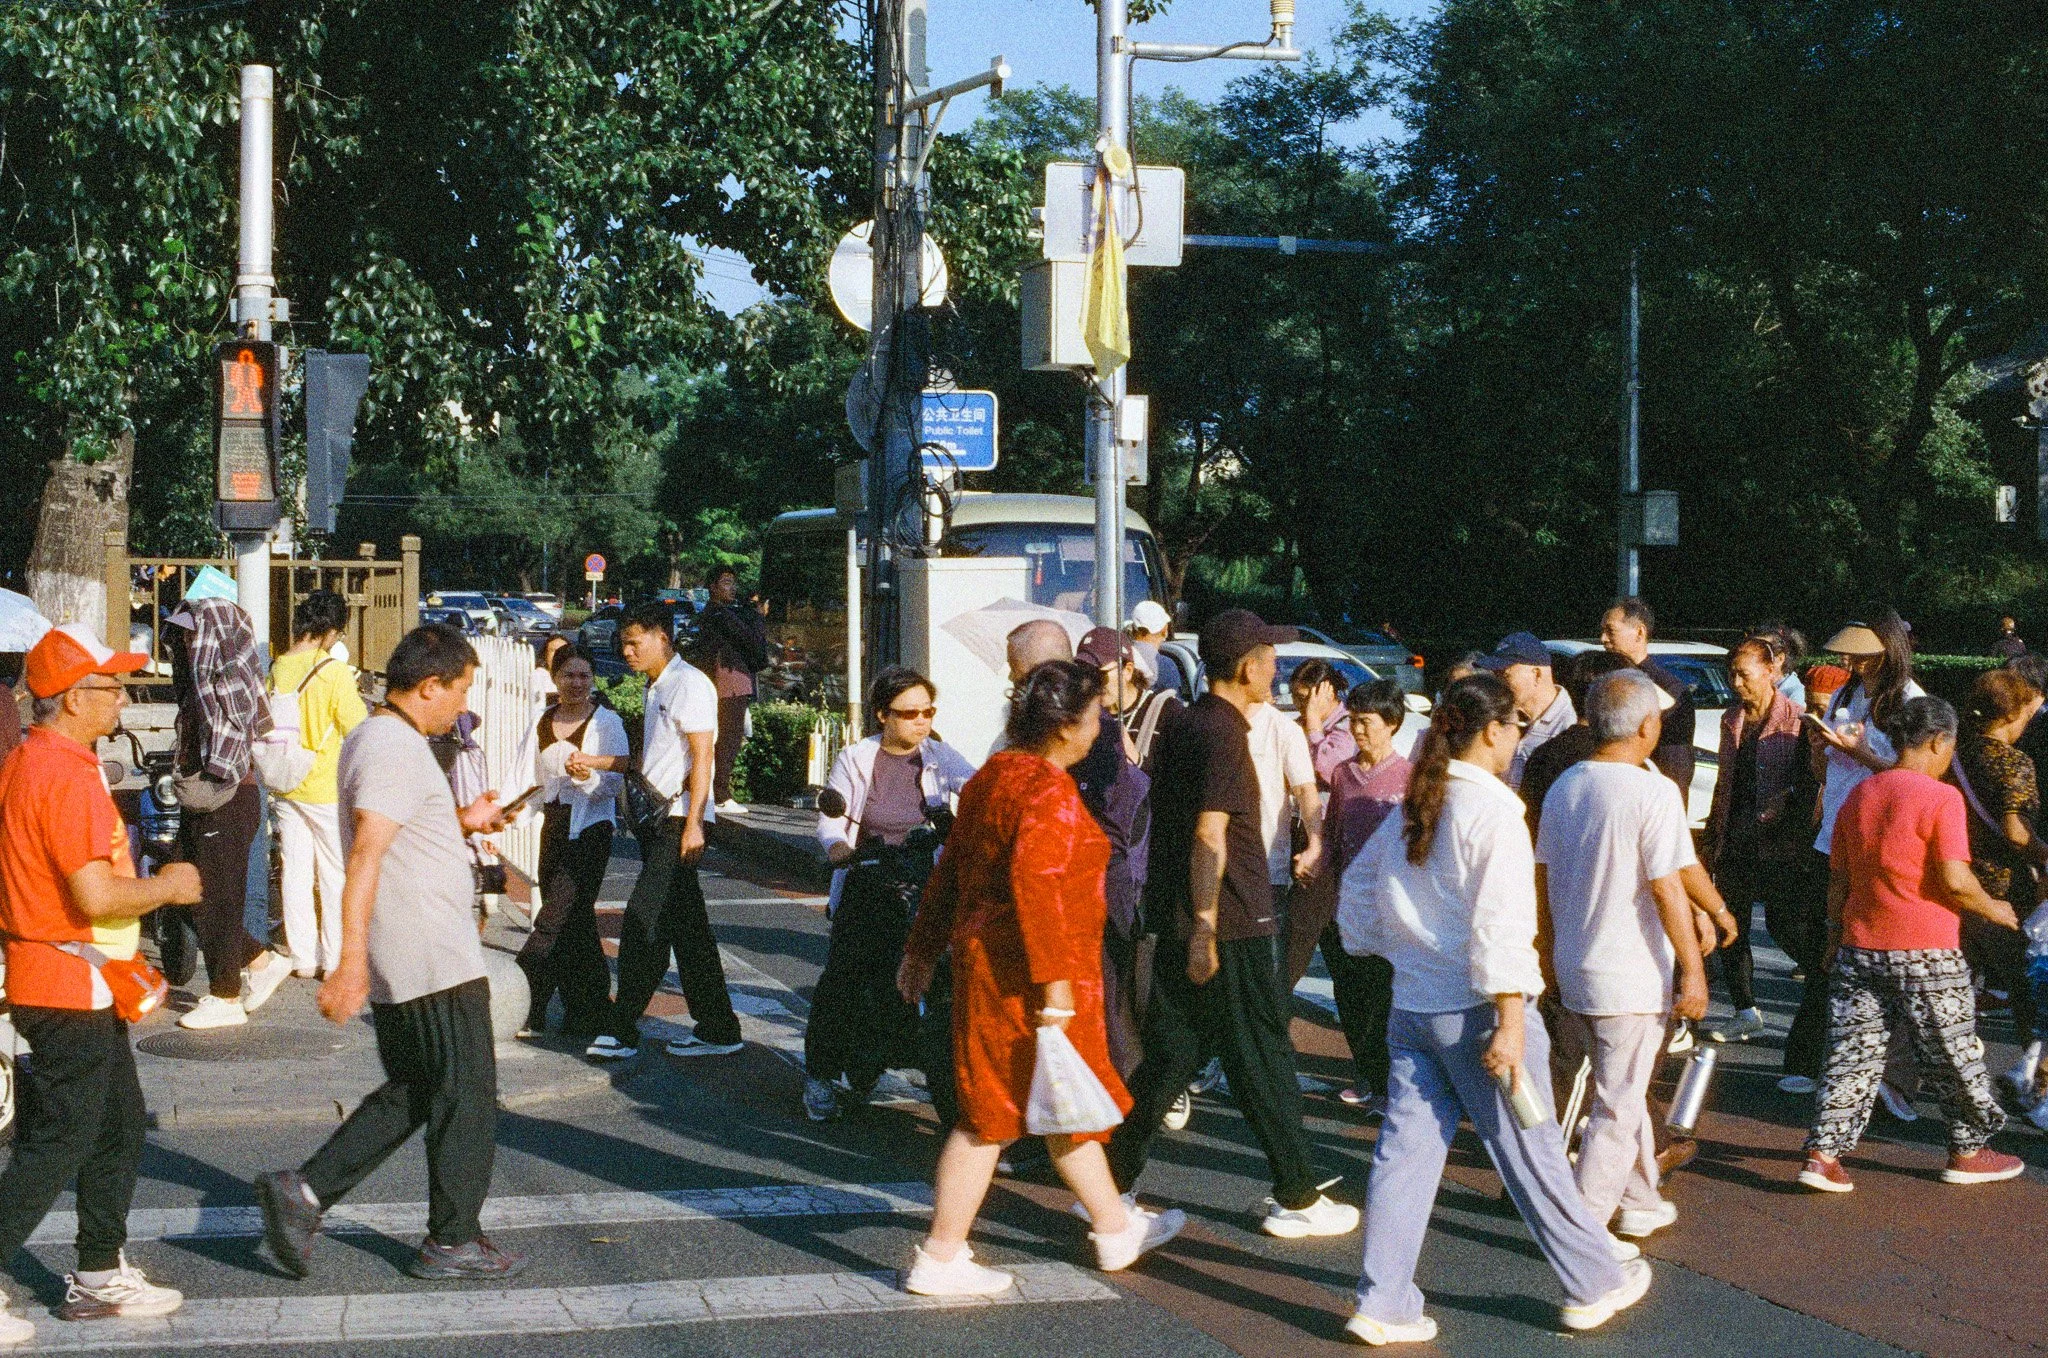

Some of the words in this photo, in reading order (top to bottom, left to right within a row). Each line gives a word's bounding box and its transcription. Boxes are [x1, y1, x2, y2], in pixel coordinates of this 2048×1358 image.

[922, 407, 986, 422] 公共卫生间
[924, 426, 954, 435] Public
[957, 426, 984, 436] Toilet
